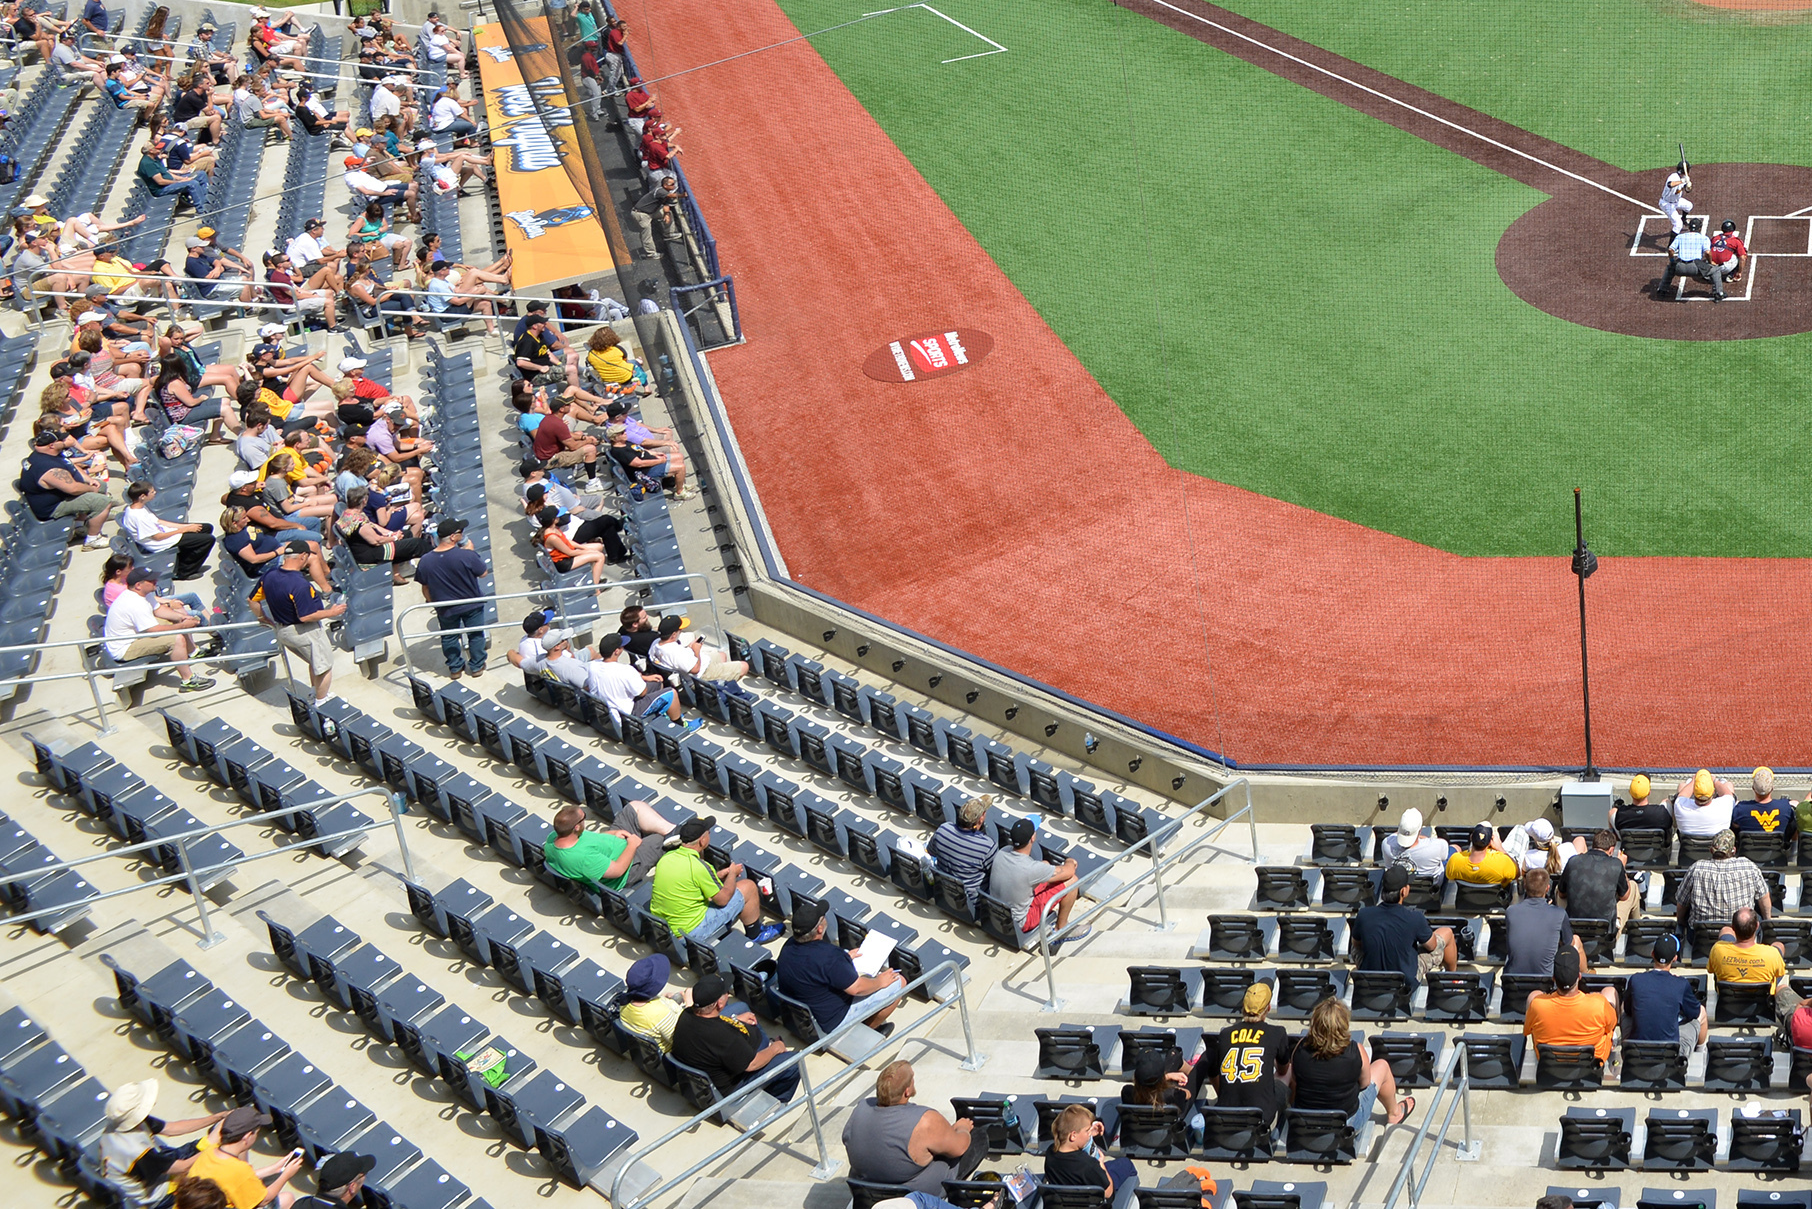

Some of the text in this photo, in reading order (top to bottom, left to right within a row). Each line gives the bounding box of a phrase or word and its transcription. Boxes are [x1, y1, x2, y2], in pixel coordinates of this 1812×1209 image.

[491, 76, 566, 118] West
[492, 107, 574, 173] Virginia
[922, 337, 949, 368] SPORTS
[1230, 1028, 1265, 1045] COLE
[1220, 1046, 1265, 1084] 45
